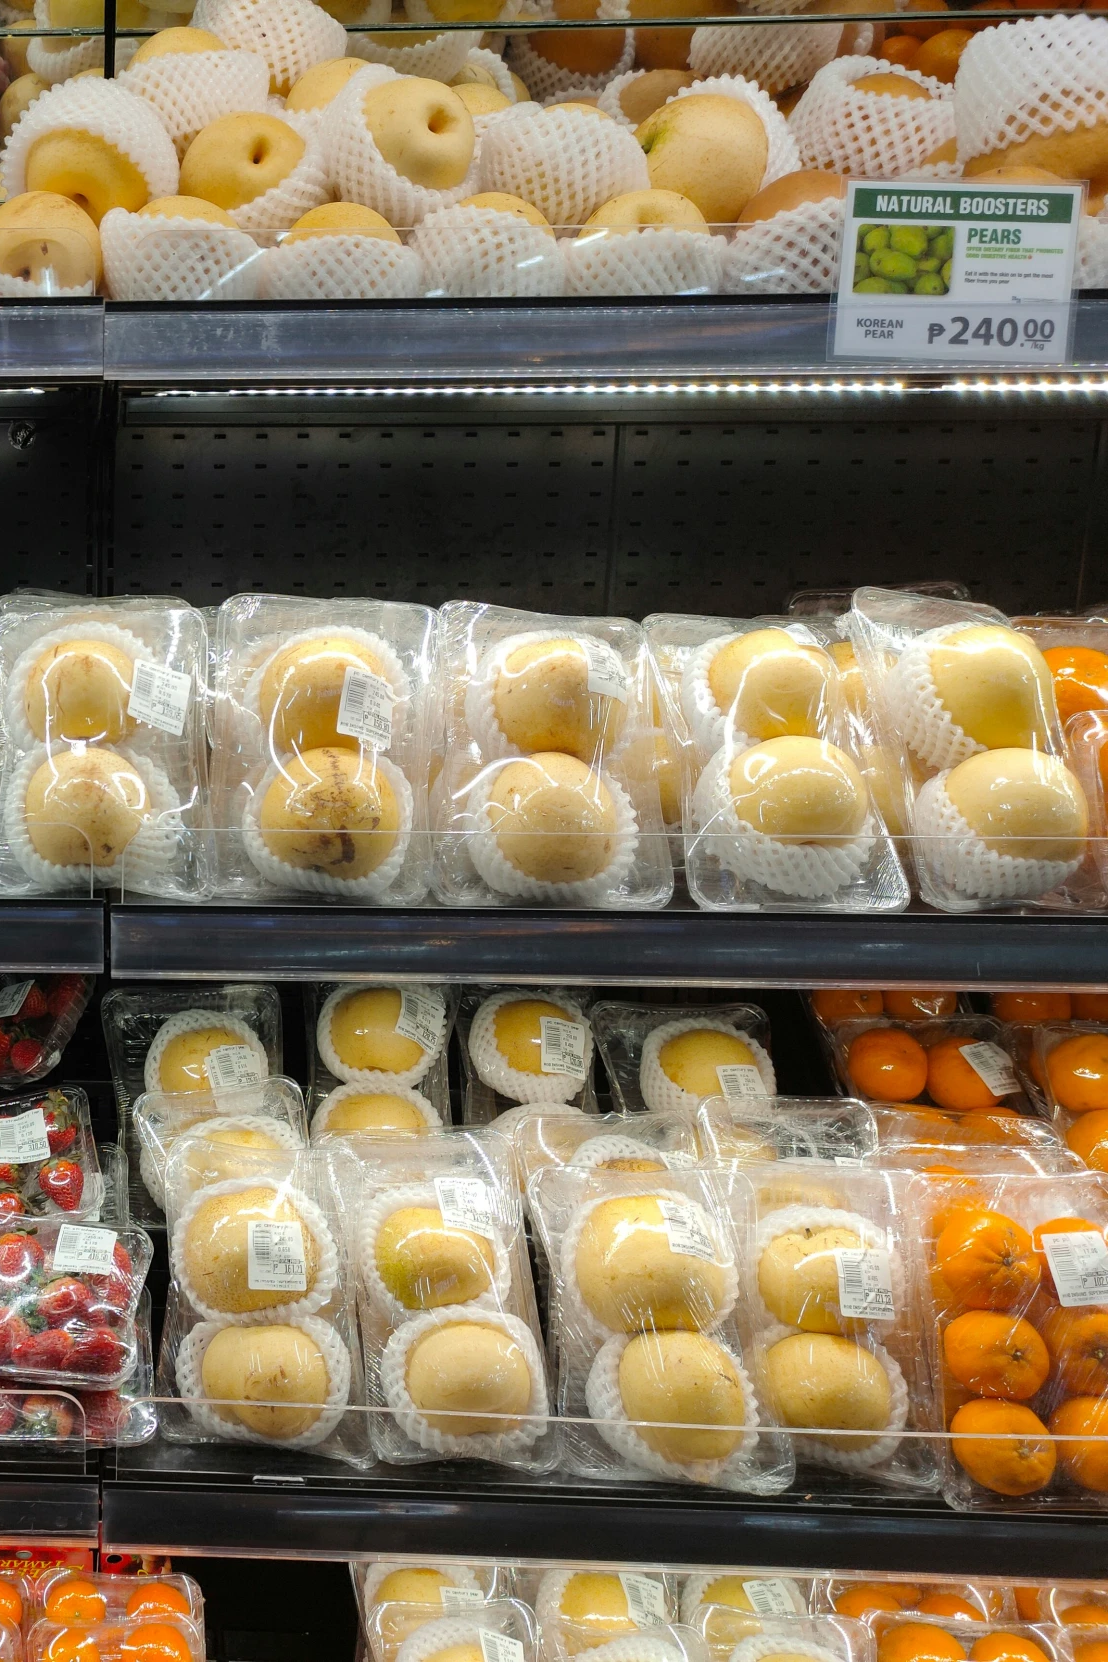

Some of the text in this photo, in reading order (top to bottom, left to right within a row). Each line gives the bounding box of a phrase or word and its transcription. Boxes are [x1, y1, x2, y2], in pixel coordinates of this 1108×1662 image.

[876, 195, 1049, 216] NATURAL BOOSTERS
[967, 228, 1022, 245] PEARS
[856, 318, 904, 328] KOREAN
[864, 329, 894, 339] PEAR
[1030, 342, 1045, 350] /kg
